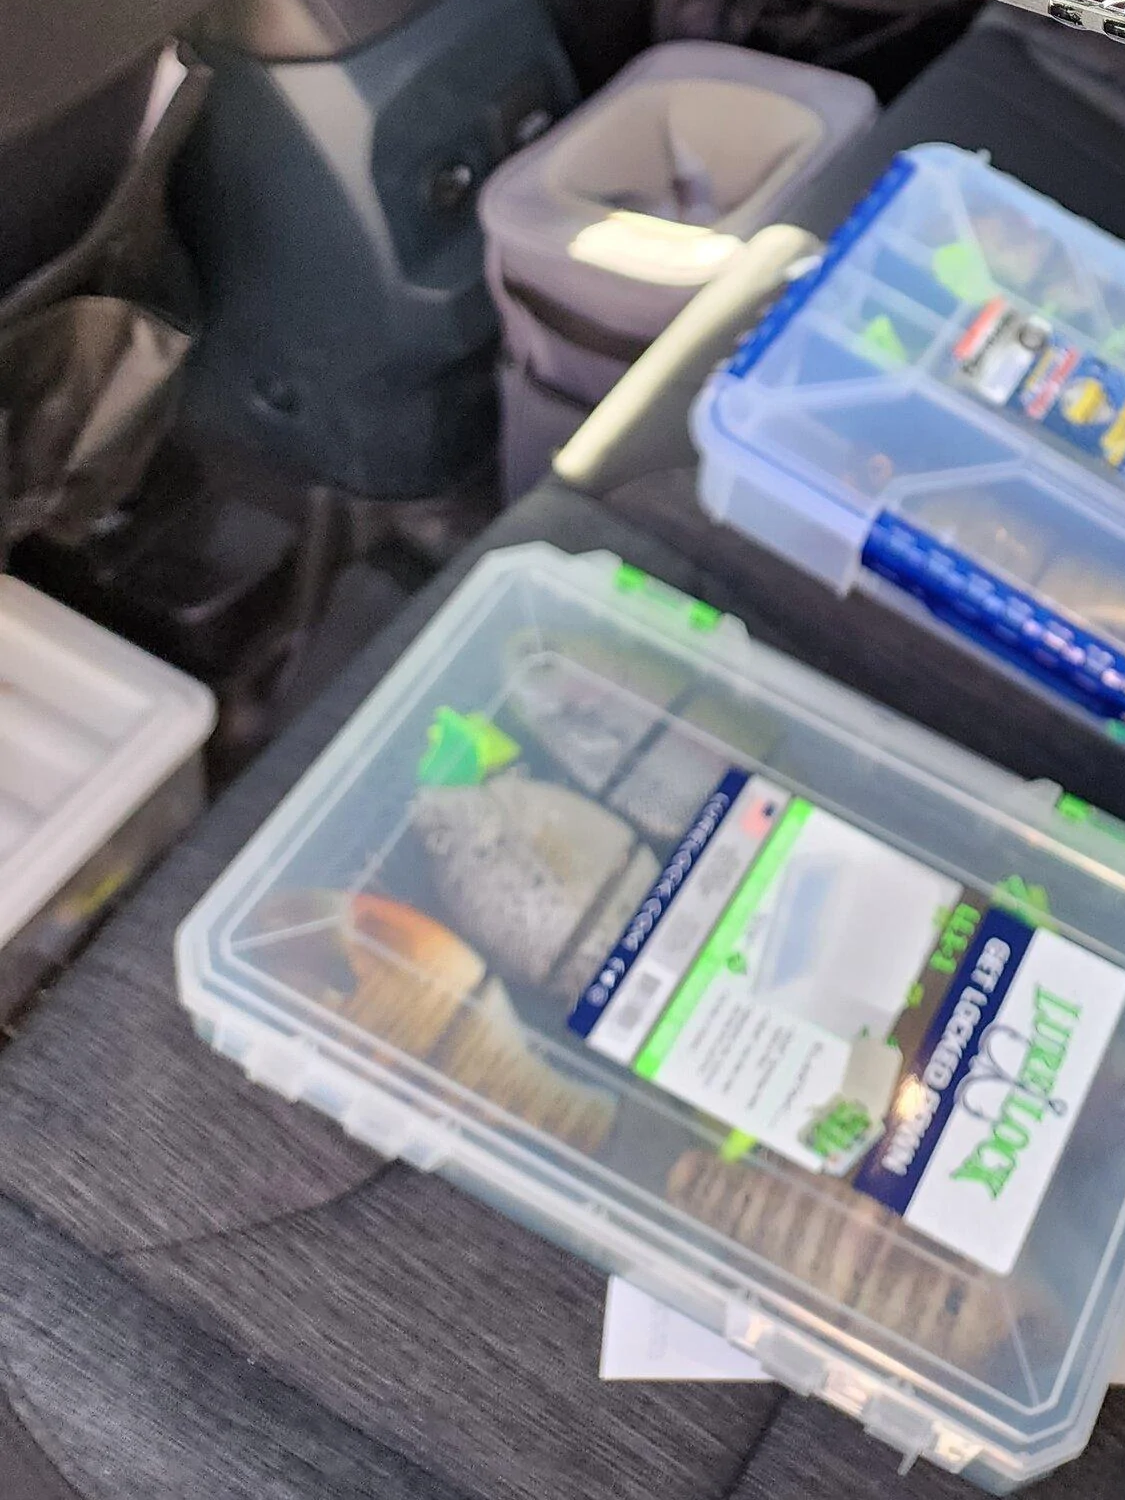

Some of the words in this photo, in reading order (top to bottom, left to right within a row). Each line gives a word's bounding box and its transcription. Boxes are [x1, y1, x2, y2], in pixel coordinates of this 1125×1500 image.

[970, 936, 1011, 994] GET
[922, 985, 988, 1091] LOCKED
[1018, 984, 1081, 1099] LURE
[881, 1089, 942, 1177] DOWN
[949, 1093, 1044, 1199] LOCK
